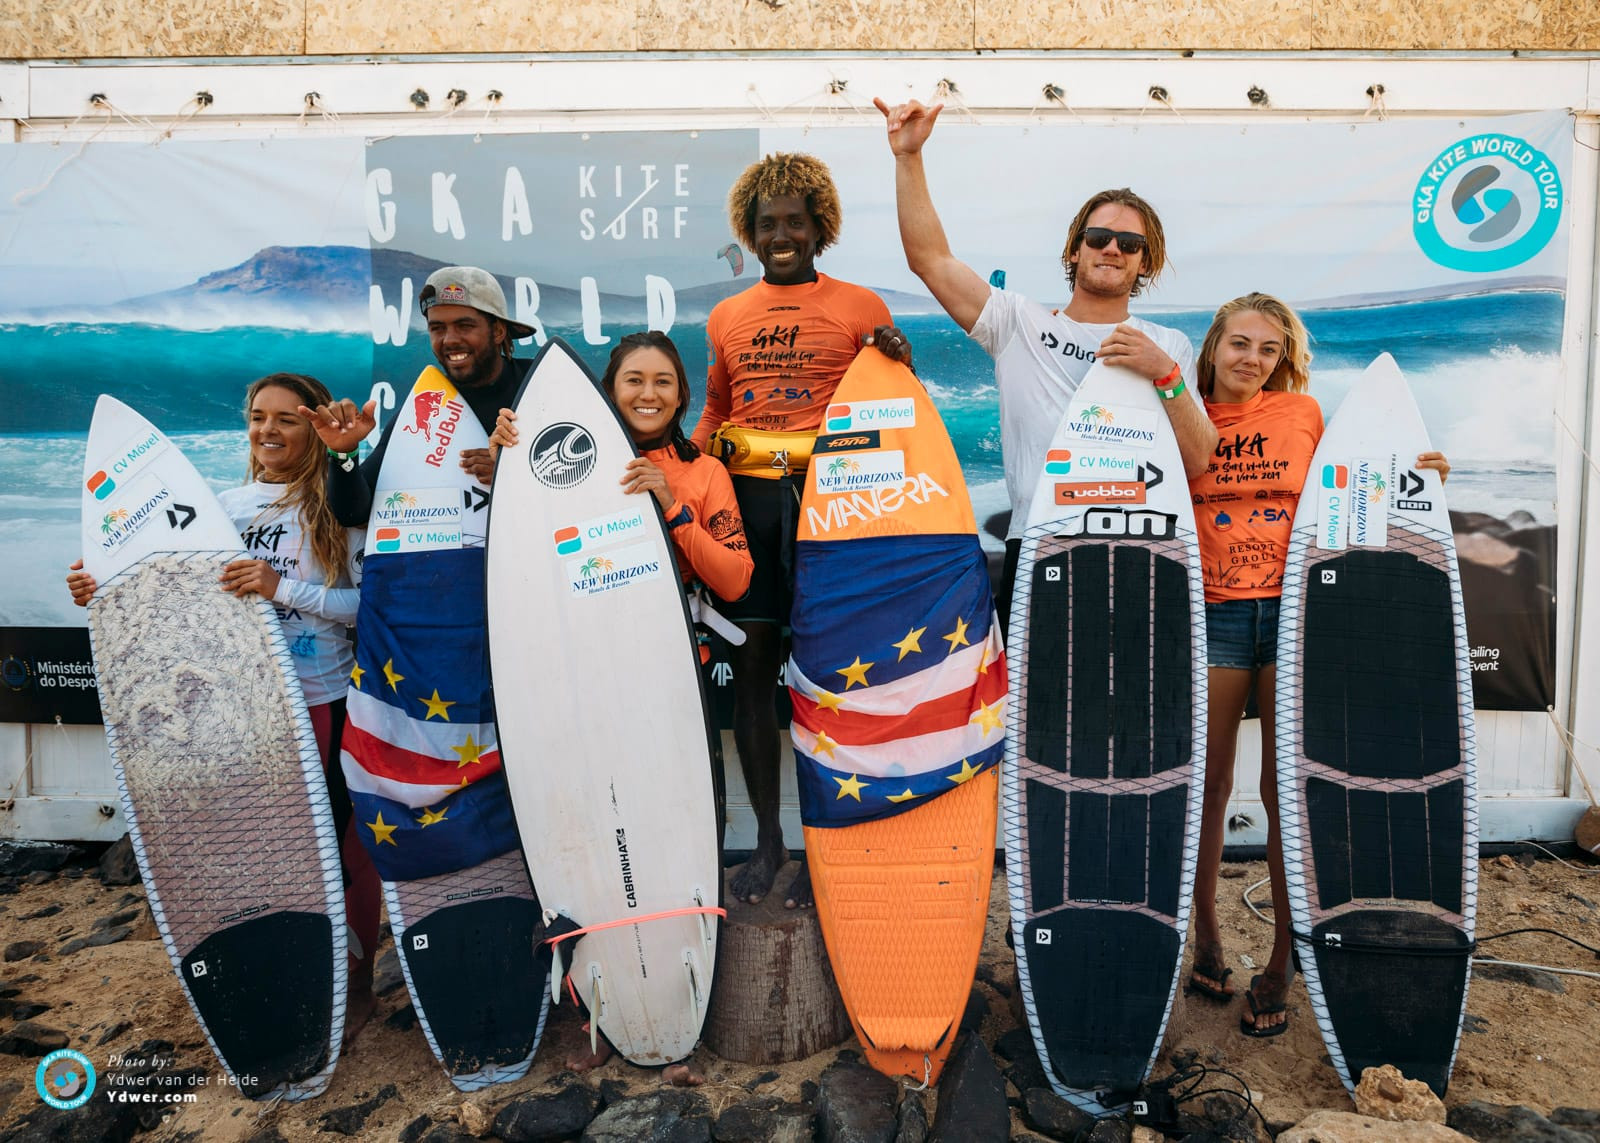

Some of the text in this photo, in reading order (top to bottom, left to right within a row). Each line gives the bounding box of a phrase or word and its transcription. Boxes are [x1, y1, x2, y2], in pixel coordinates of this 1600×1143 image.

[579, 164, 689, 198] KITE
[1418, 138, 1558, 223] GKA KITE WORLD TOUR
[366, 166, 533, 243] GKA
[579, 207, 689, 240] SURF
[369, 275, 676, 346] WRLD
[859, 406, 913, 420] CV Móvel
[425, 400, 464, 468] Red Bull
[1067, 422, 1155, 441] NEW HORIZONS
[1215, 432, 1269, 460] GKA
[113, 432, 159, 473] CV Móvel
[1079, 456, 1134, 469] CV Móvel
[1273, 460, 1289, 471] Cup
[818, 471, 903, 487] NEW HORIZONS
[1261, 472, 1280, 480] 2019
[376, 507, 459, 520] NEW HORIZONS
[1357, 460, 1368, 544] NEW HORIZONS
[102, 488, 169, 551] NEW HORIZONS
[588, 515, 643, 540] CV Móvel
[1328, 496, 1340, 548] CV Móvel
[408, 531, 461, 543] CV Móvel
[573, 561, 659, 592] NEW HORIZONS
[40, 675, 56, 687] do
[619, 844, 637, 908] CABRINHA
